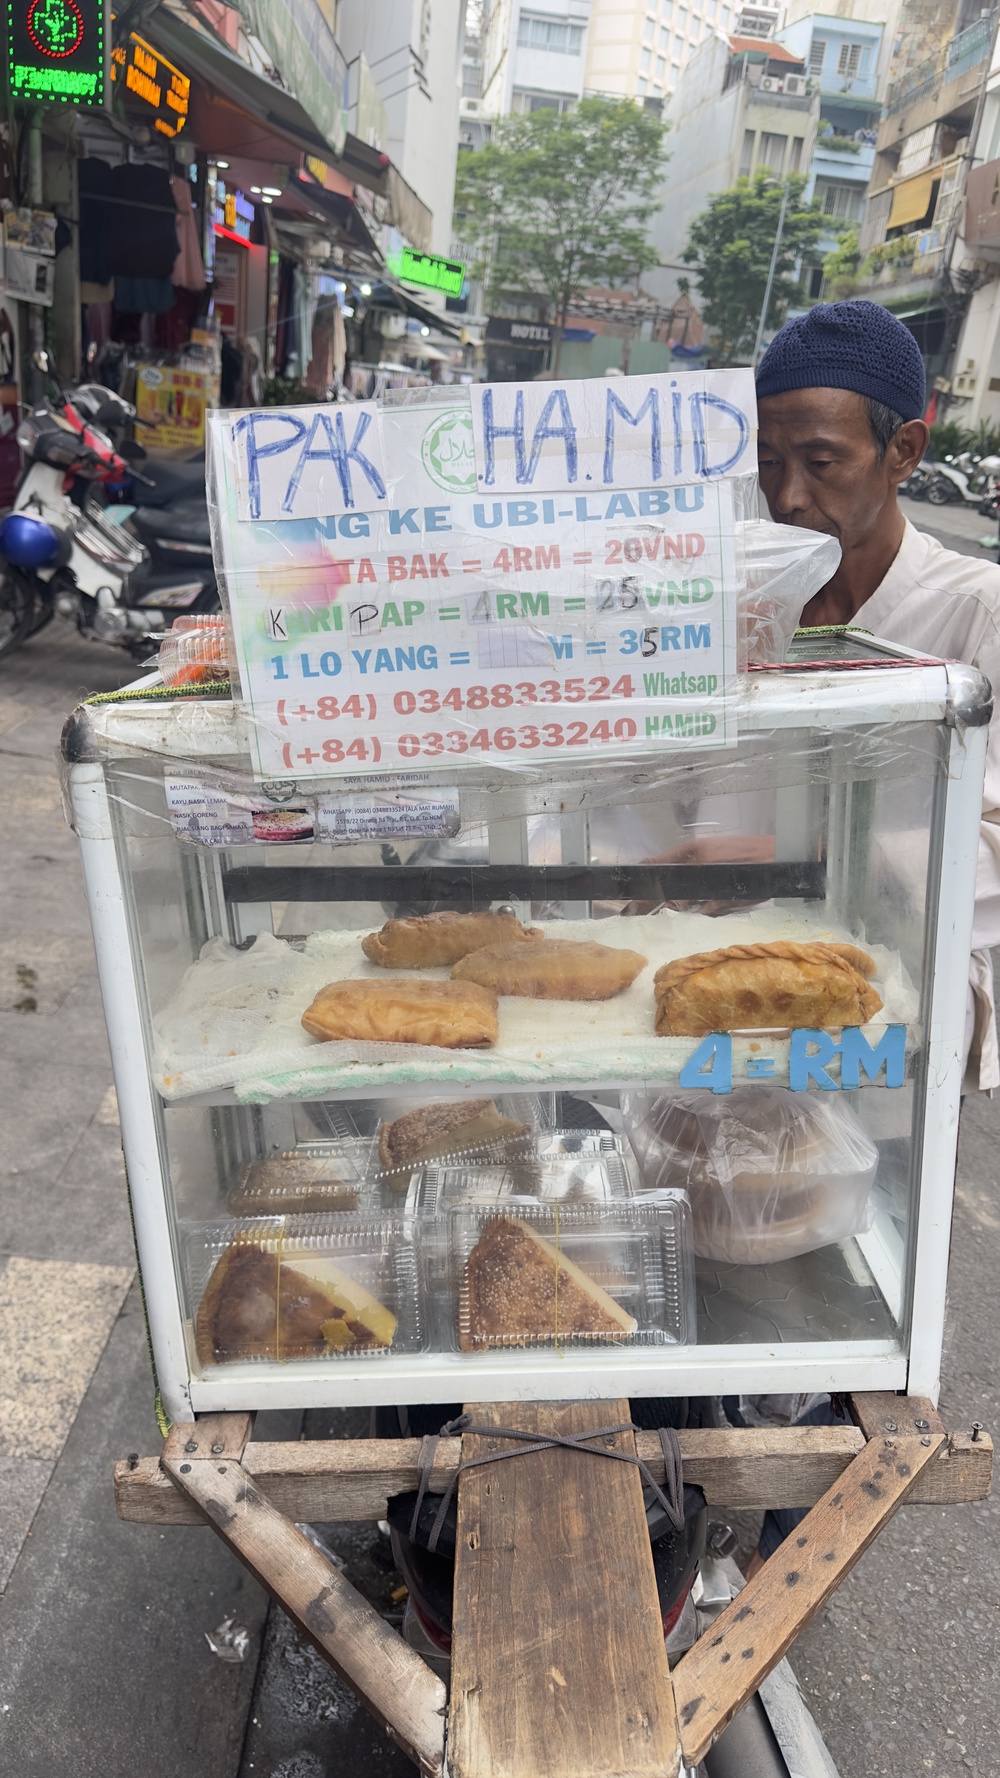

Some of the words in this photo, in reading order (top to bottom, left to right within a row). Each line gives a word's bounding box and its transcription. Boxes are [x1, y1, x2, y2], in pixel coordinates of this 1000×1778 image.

[510, 323, 551, 341] HOTEL
[231, 411, 387, 520] PAK
[389, 505, 453, 535] KE
[473, 486, 704, 529] UBI-LABU
[387, 552, 451, 582] BAK
[493, 544, 561, 573] 4RM
[271, 655, 289, 680] 1
[301, 651, 343, 678] LO
[351, 644, 438, 674] YANG
[276, 693, 378, 726] (+84)
[393, 674, 636, 716] 0348833524
[642, 671, 718, 697] Whatsap
[282, 736, 382, 769] (+84)
[397, 717, 637, 758] 0334633240
[645, 712, 717, 740] HAMID
[343, 777, 361, 785] SAYA
[363, 775, 391, 783] HAMID
[679, 1030, 733, 1095] 4
[789, 1023, 908, 1092] RM
